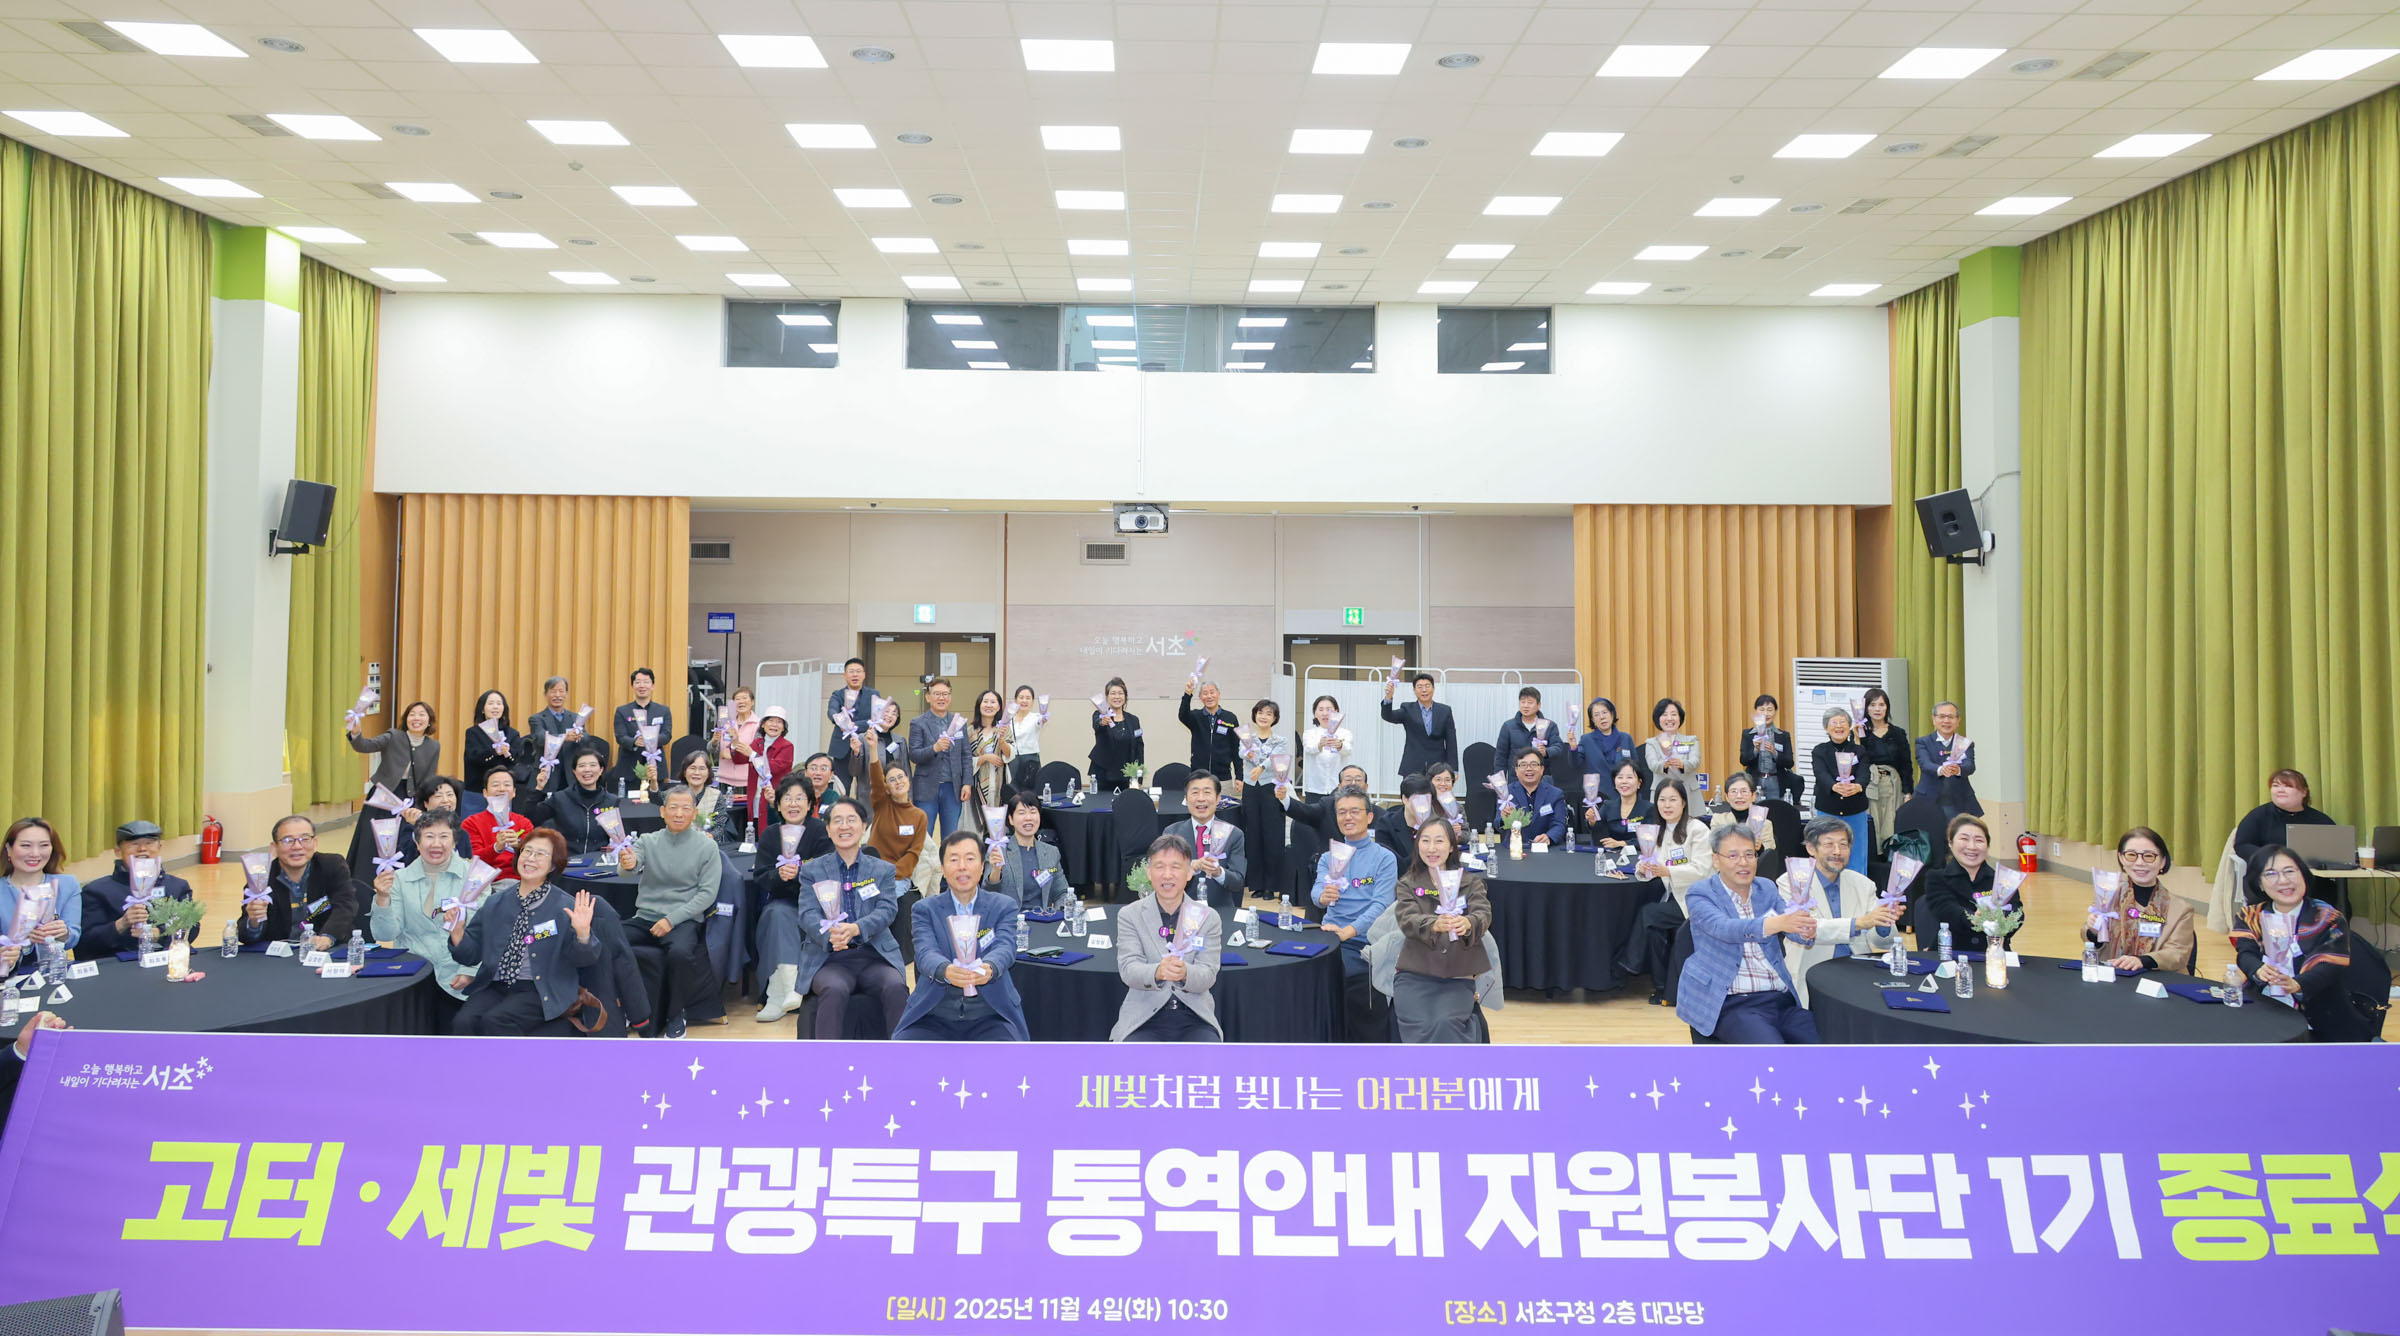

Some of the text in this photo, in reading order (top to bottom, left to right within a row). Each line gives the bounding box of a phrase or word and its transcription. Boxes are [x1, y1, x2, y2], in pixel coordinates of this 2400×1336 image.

[1145, 635, 1186, 656] 서초
[851, 878, 876, 889] English
[2140, 912, 2165, 923] English
[79, 1063, 144, 1076] 오늘 행복하고
[142, 1063, 195, 1091] 서초
[60, 1075, 141, 1090] 내일이 기다려지는
[1075, 1073, 1540, 1111] 세빛처럼 빛나는 여러분에게
[623, 1147, 1022, 1255] 관광특구
[1046, 1148, 1445, 1257] 통역안내
[1464, 1150, 1973, 1261] 자원봉사단
[1987, 1152, 2143, 1260] 1기
[886, 1296, 1229, 1322] [일시] 2025년 11월 4일(화) 10:30
[1445, 1298, 1705, 1326] [장소] 서초구청 2층 대강당
